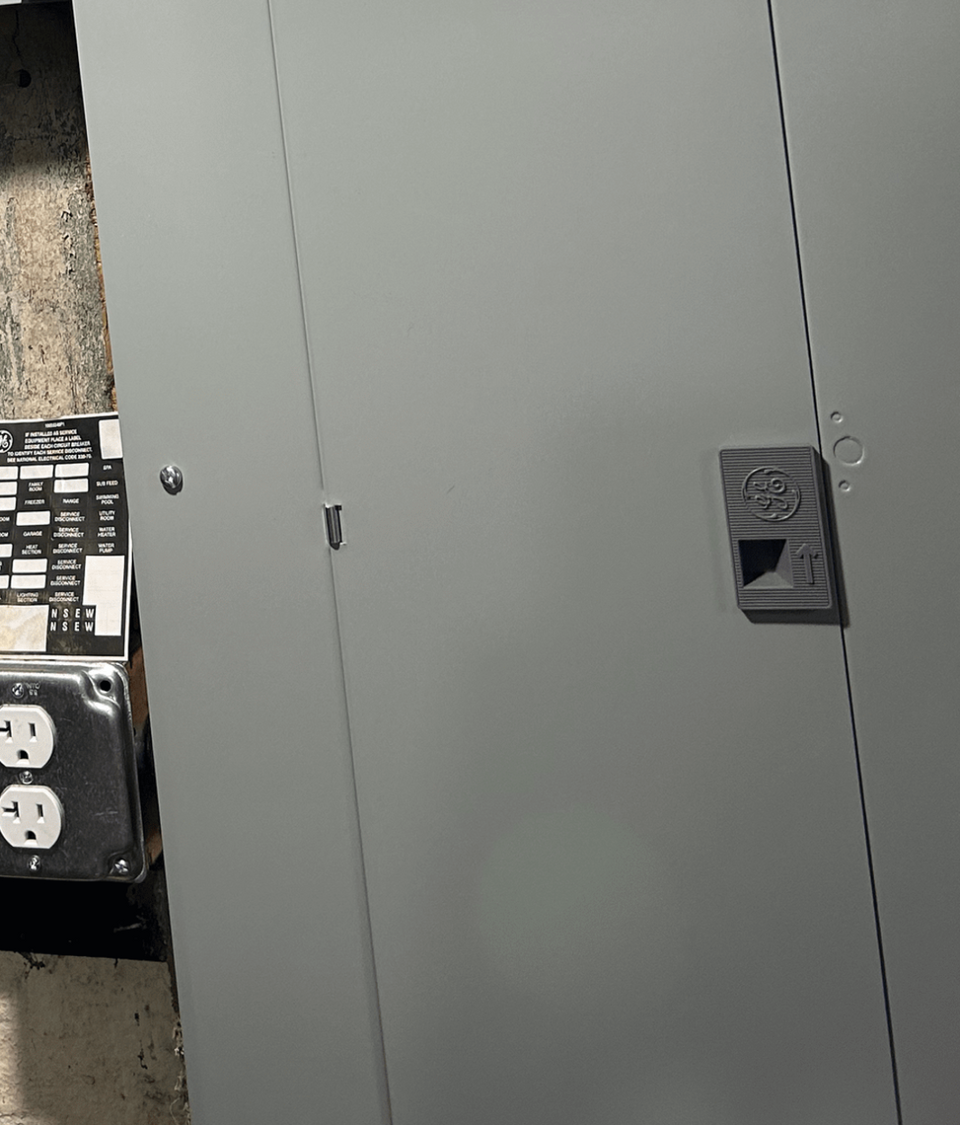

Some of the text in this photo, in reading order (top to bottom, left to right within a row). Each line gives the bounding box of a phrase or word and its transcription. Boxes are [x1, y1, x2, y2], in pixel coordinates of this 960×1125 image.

[51, 608, 94, 618] N S E W
[50, 622, 93, 631] N S E W
